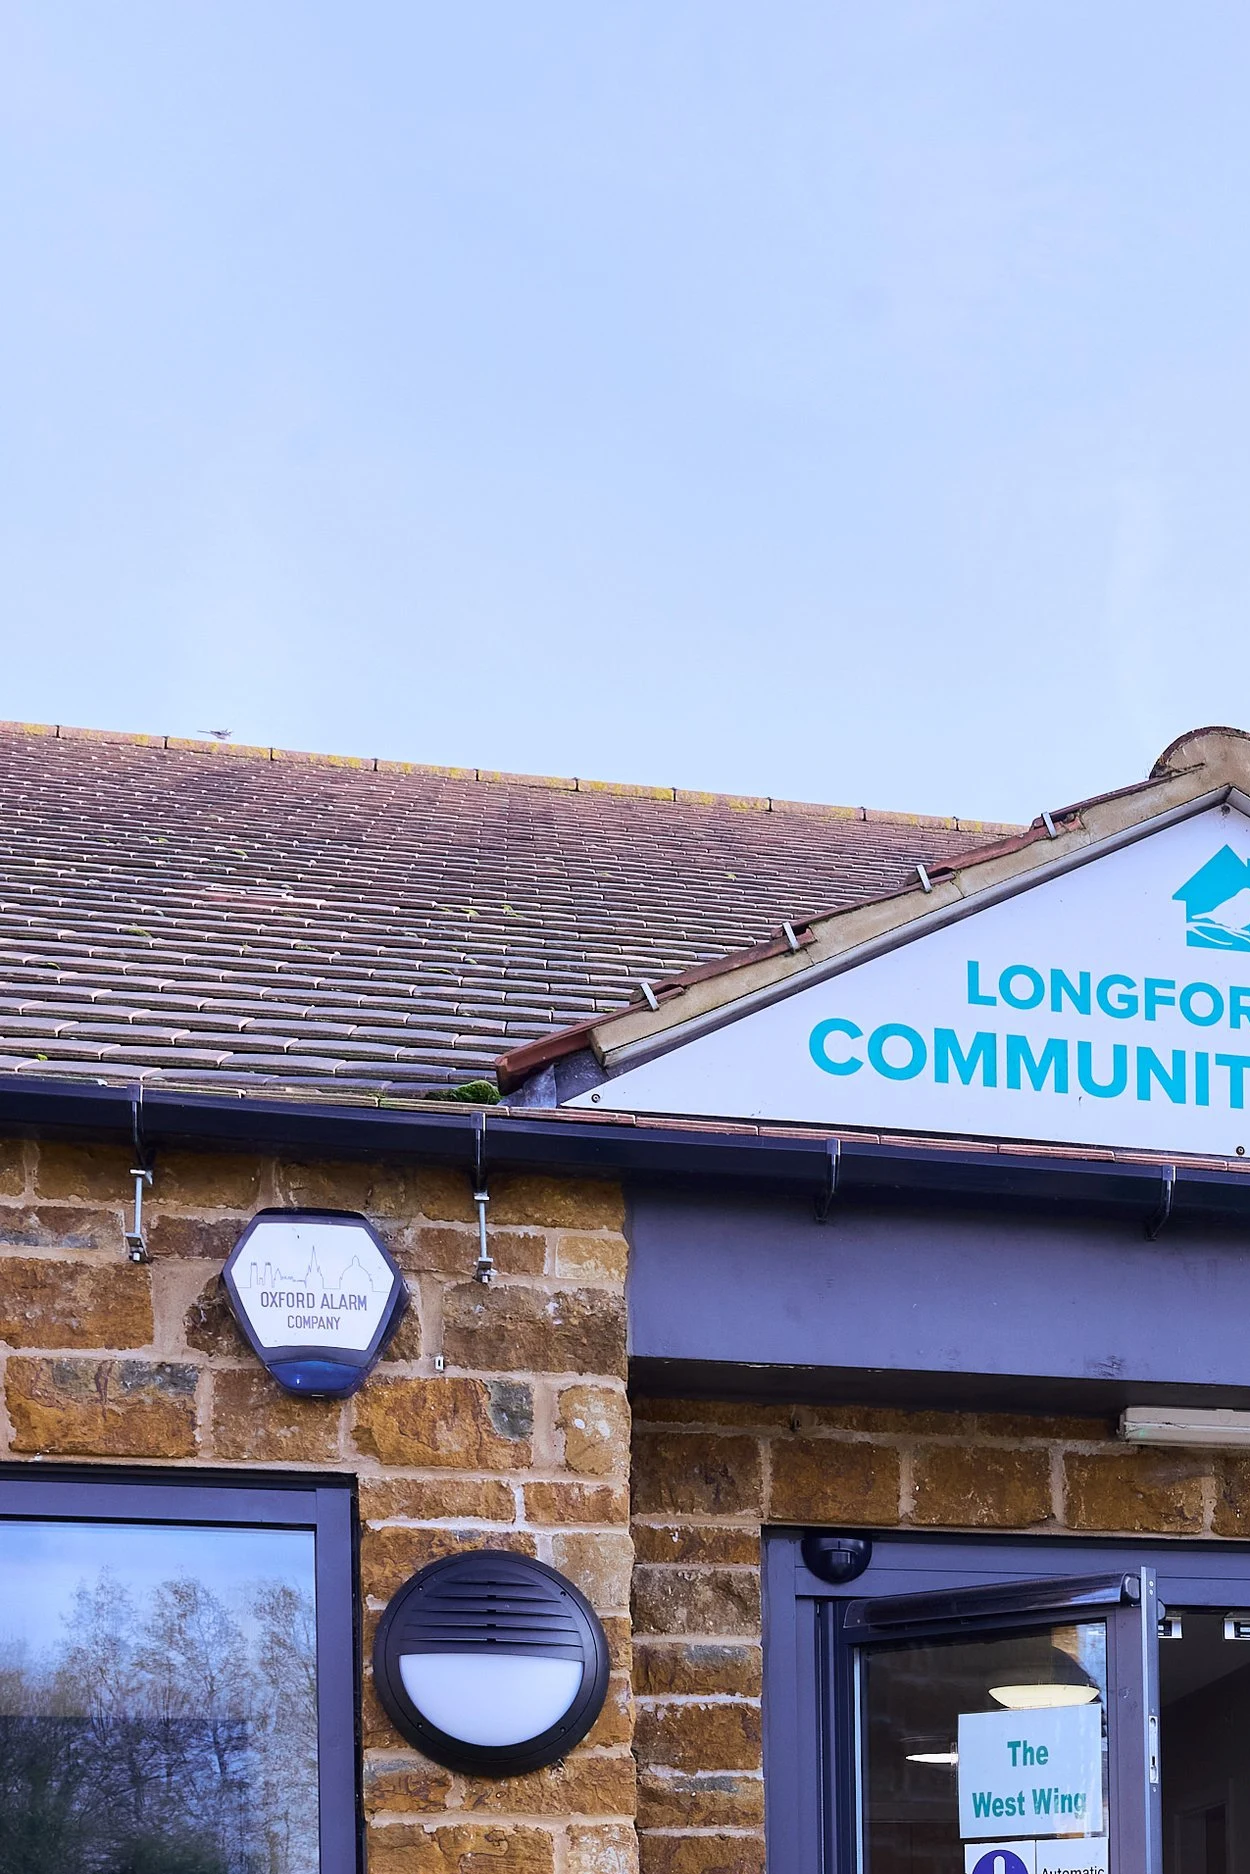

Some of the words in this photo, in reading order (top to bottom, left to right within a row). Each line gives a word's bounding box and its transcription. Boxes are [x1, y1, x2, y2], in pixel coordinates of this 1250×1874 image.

[260, 1291, 316, 1309] OXFORD
[320, 1293, 368, 1312] ALARM
[287, 1314, 341, 1331] COMPANY
[1006, 1740, 1049, 1768] The
[971, 1789, 1026, 1819] West
[1031, 1787, 1088, 1819] Wing
